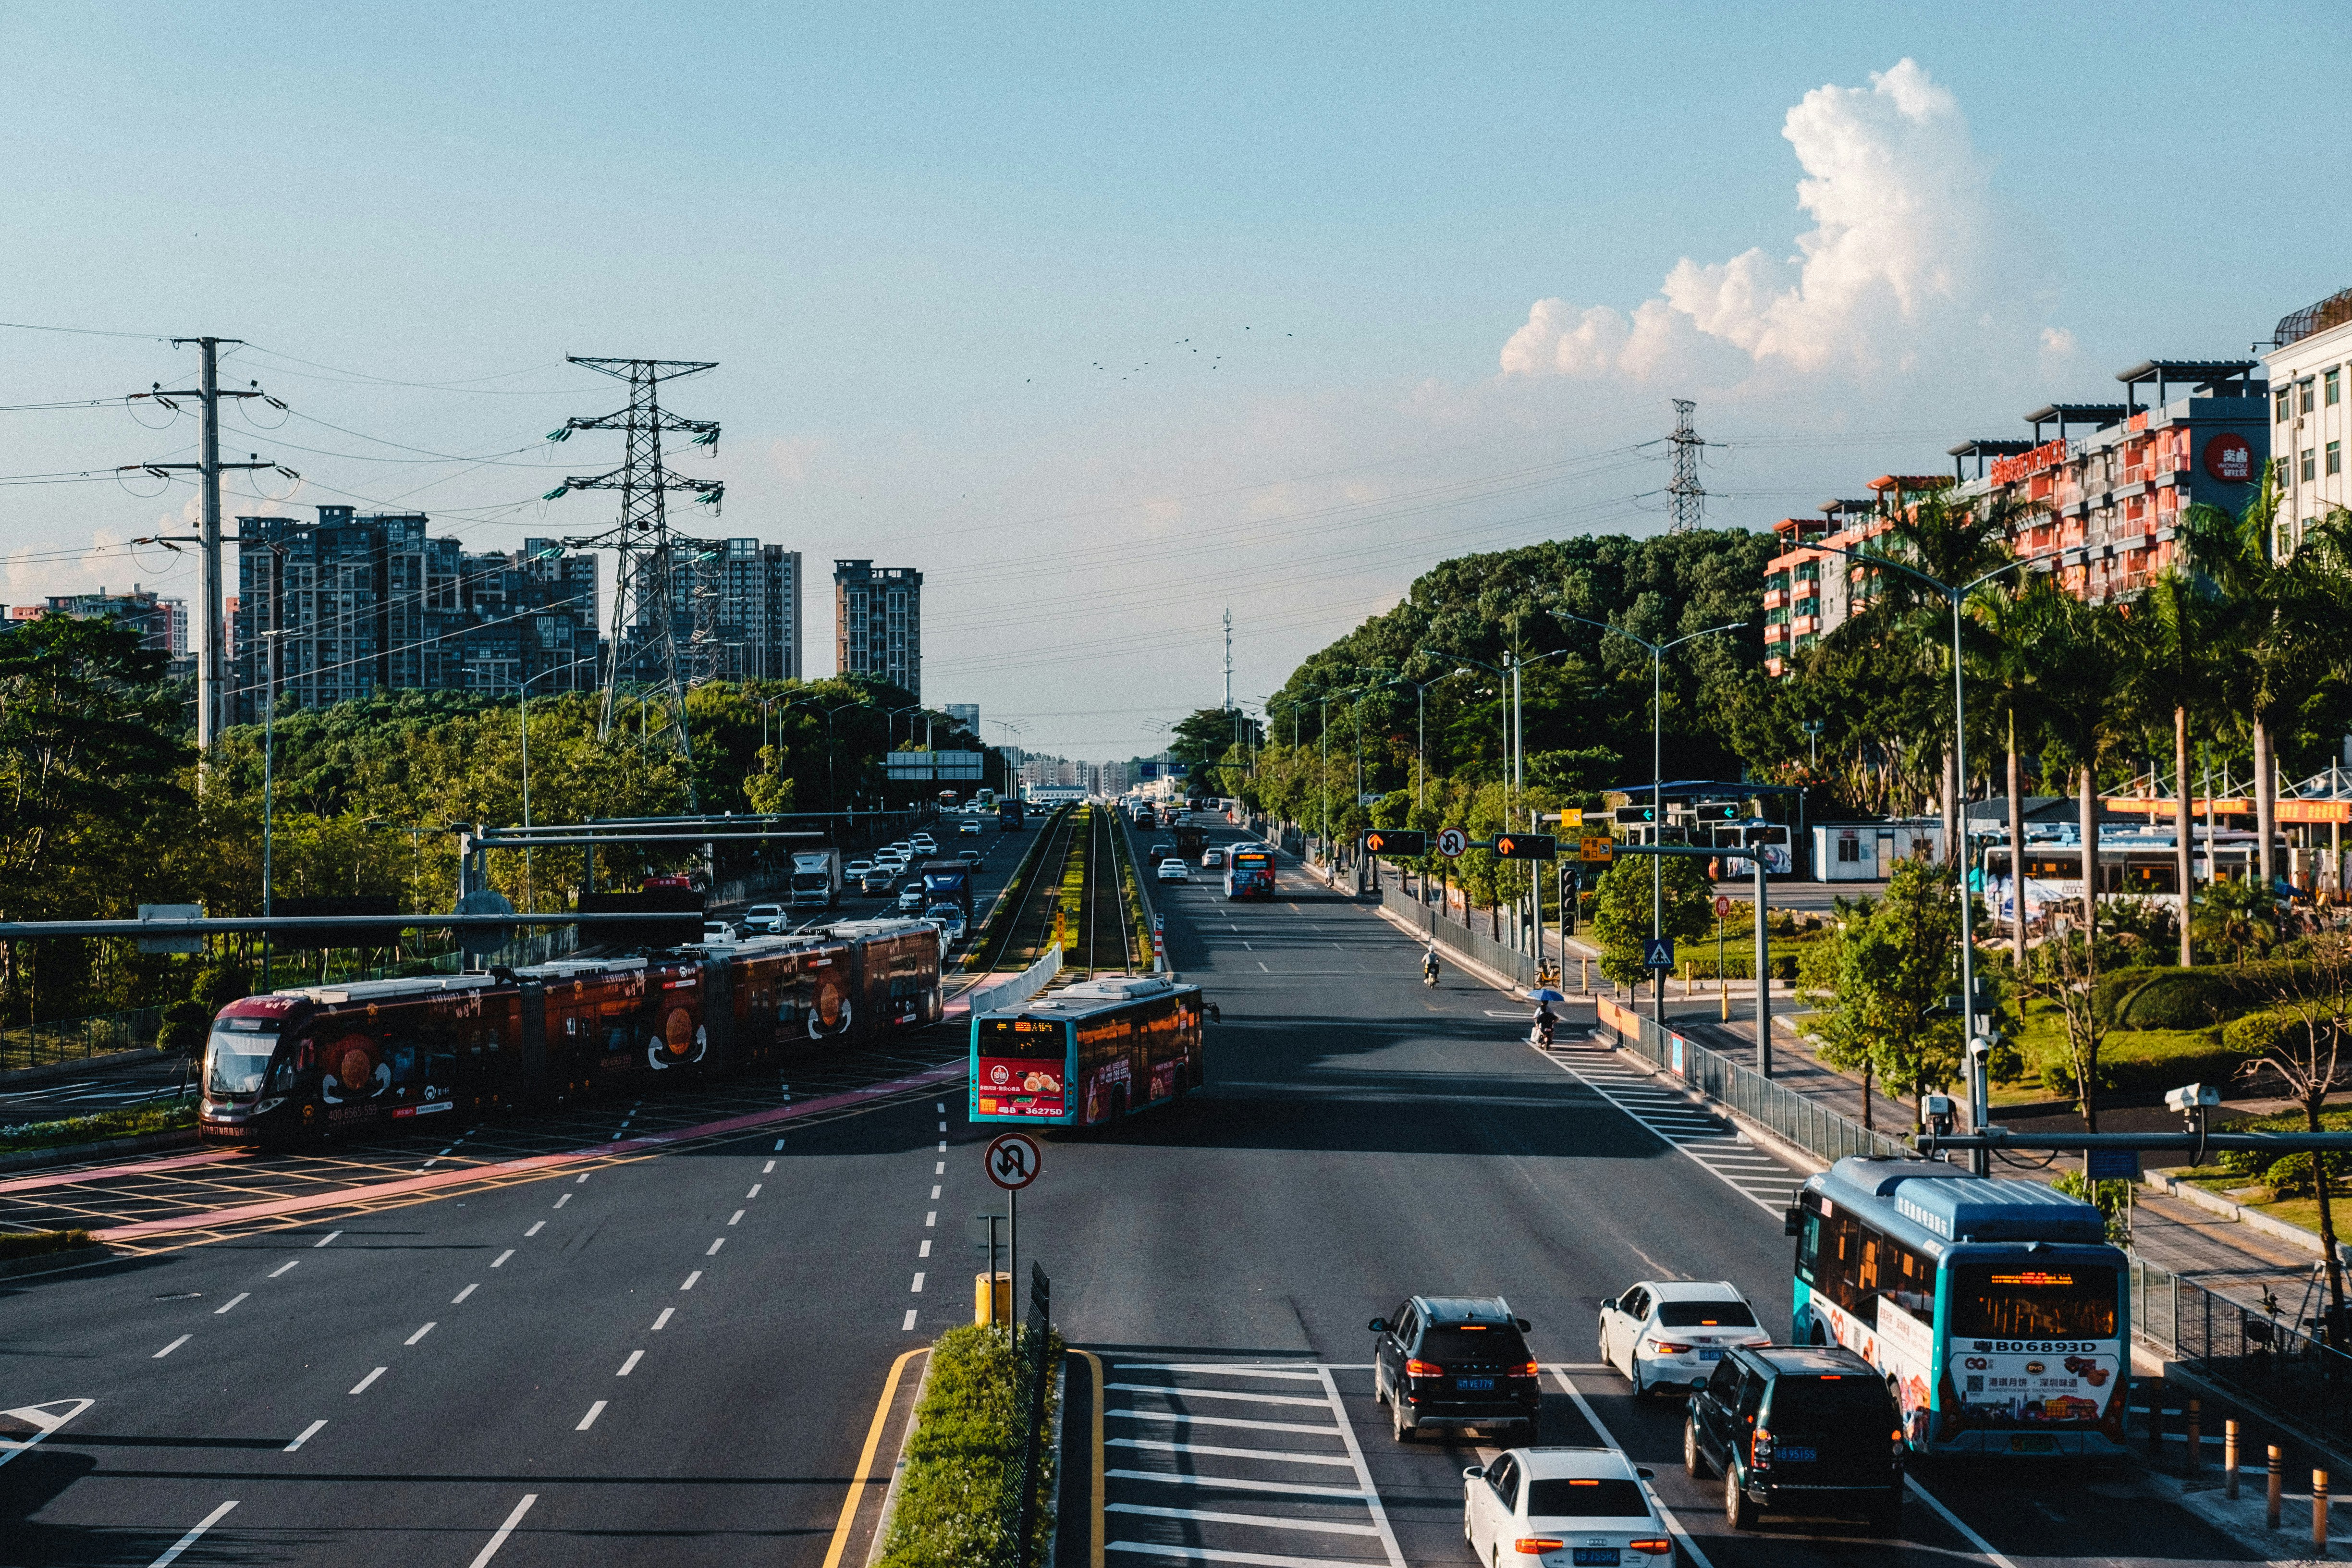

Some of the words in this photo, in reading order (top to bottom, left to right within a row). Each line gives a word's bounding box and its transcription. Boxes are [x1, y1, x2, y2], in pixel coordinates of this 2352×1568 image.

[1583, 839, 1598, 847] 严管
[1583, 850, 1598, 859] 路口
[328, 1103, 378, 1121] 400-6565-559
[1025, 1107, 1063, 1115] 36275D
[2040, 1378, 2078, 1388] 深圳味道
